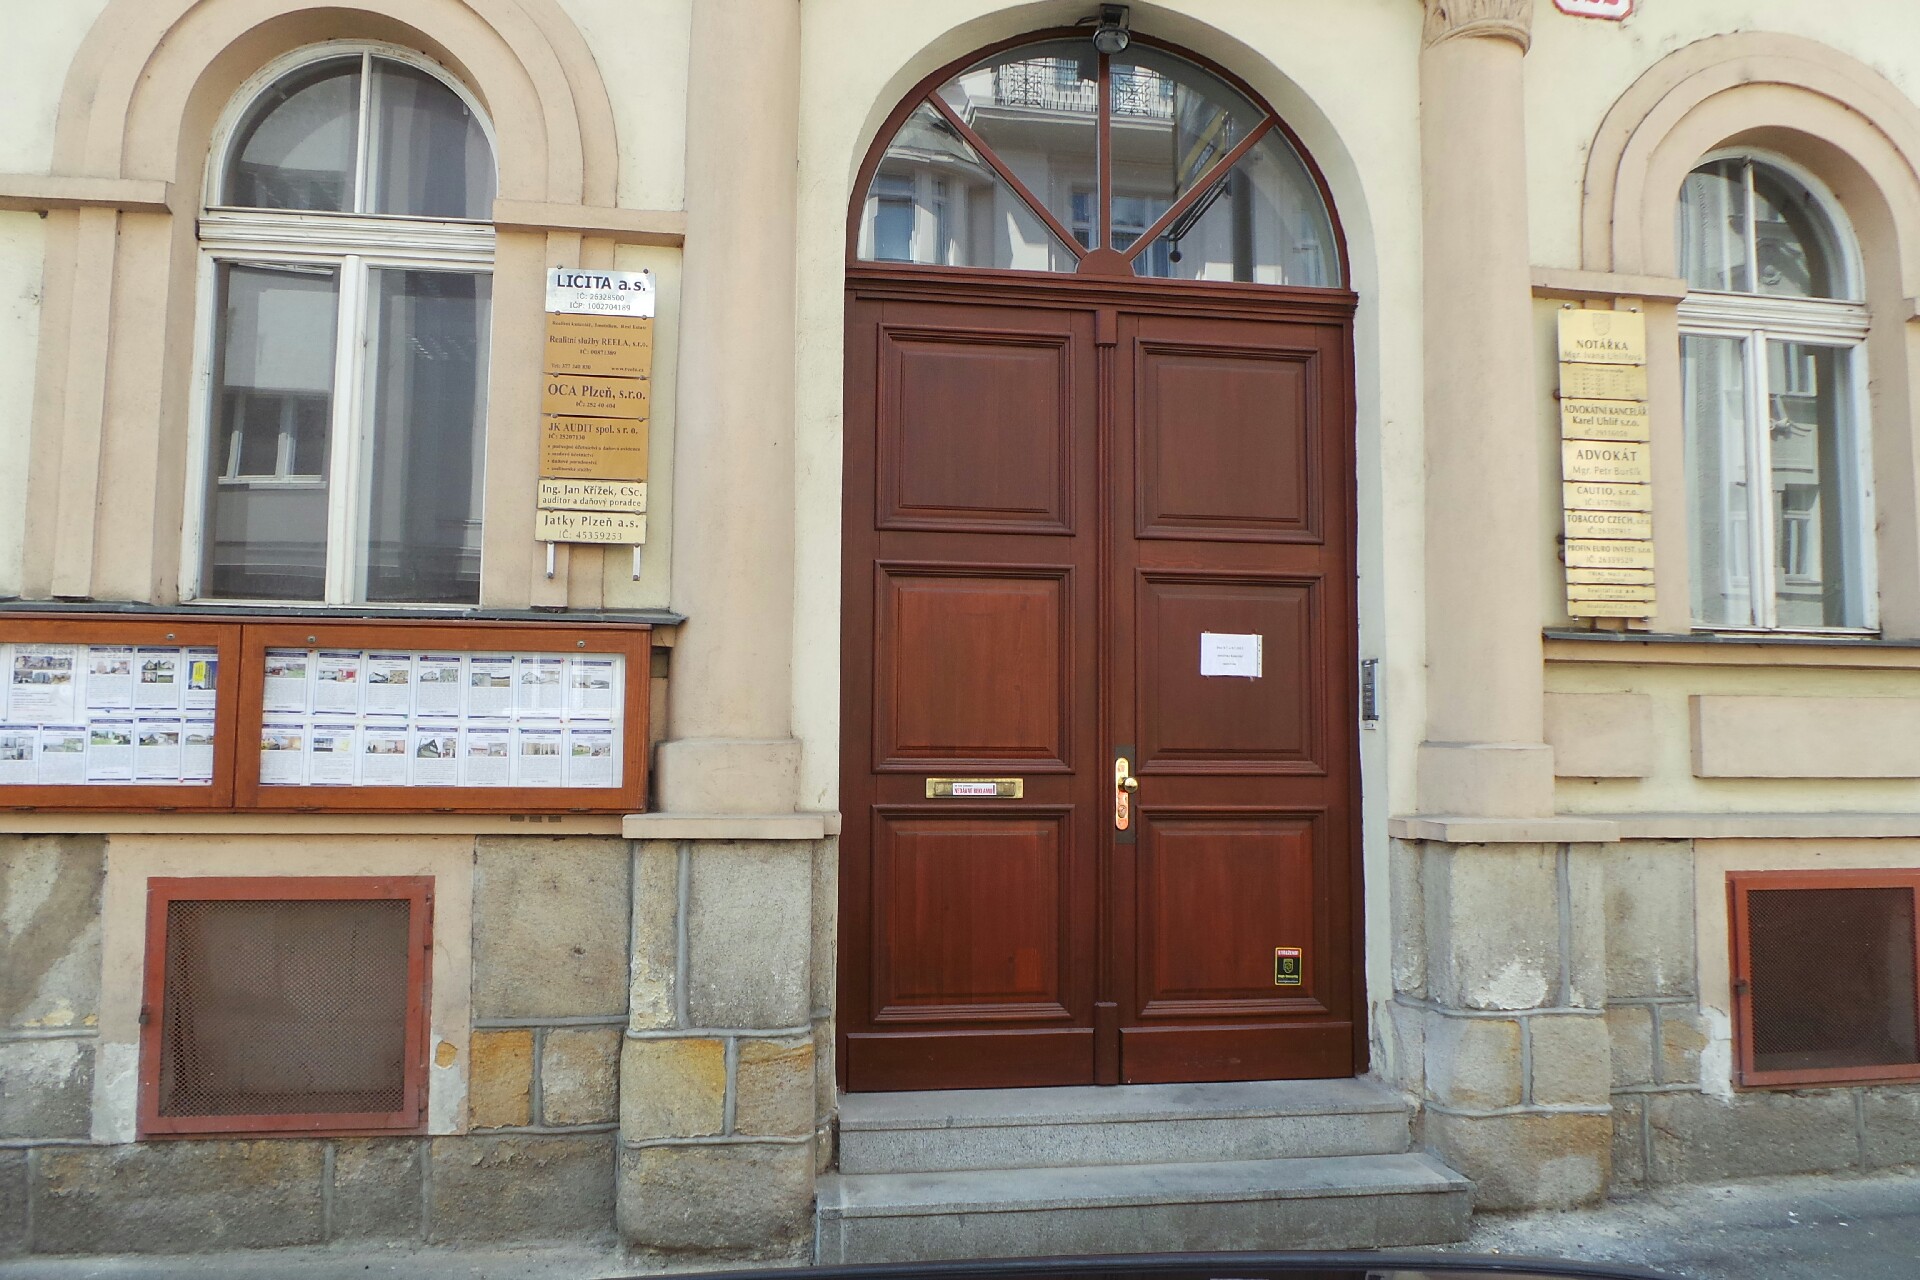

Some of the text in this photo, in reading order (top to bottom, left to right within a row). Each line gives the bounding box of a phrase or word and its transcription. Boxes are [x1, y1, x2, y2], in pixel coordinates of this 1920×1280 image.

[557, 274, 646, 291] LICITA a.s.
[549, 335, 576, 344] Realitní
[578, 337, 600, 346] služby
[1576, 338, 1628, 350] NOTÁŘKA
[548, 384, 646, 400] OCA Plzeň, s.r.o.
[1564, 404, 1647, 416] ADVOKÁTNÍ KANCELÁŘ
[1573, 416, 1594, 425] Karel
[1597, 417, 1618, 425] Uhlíř
[548, 423, 561, 432] JK
[563, 423, 593, 432] AUDIT
[596, 425, 614, 435] spol.
[1576, 448, 1637, 461] ADVOKÁT
[1573, 466, 1590, 475] Mgr.
[1594, 466, 1611, 474] Petr
[542, 484, 642, 497] Ing. Jan Křížek, CSc.
[1577, 486, 1616, 496] CAUTIO,
[580, 498, 607, 506] daňový
[609, 499, 641, 507] poradce
[544, 515, 639, 528] Jatky Plzeň a.s.
[1567, 514, 1604, 523] TOBACCO
